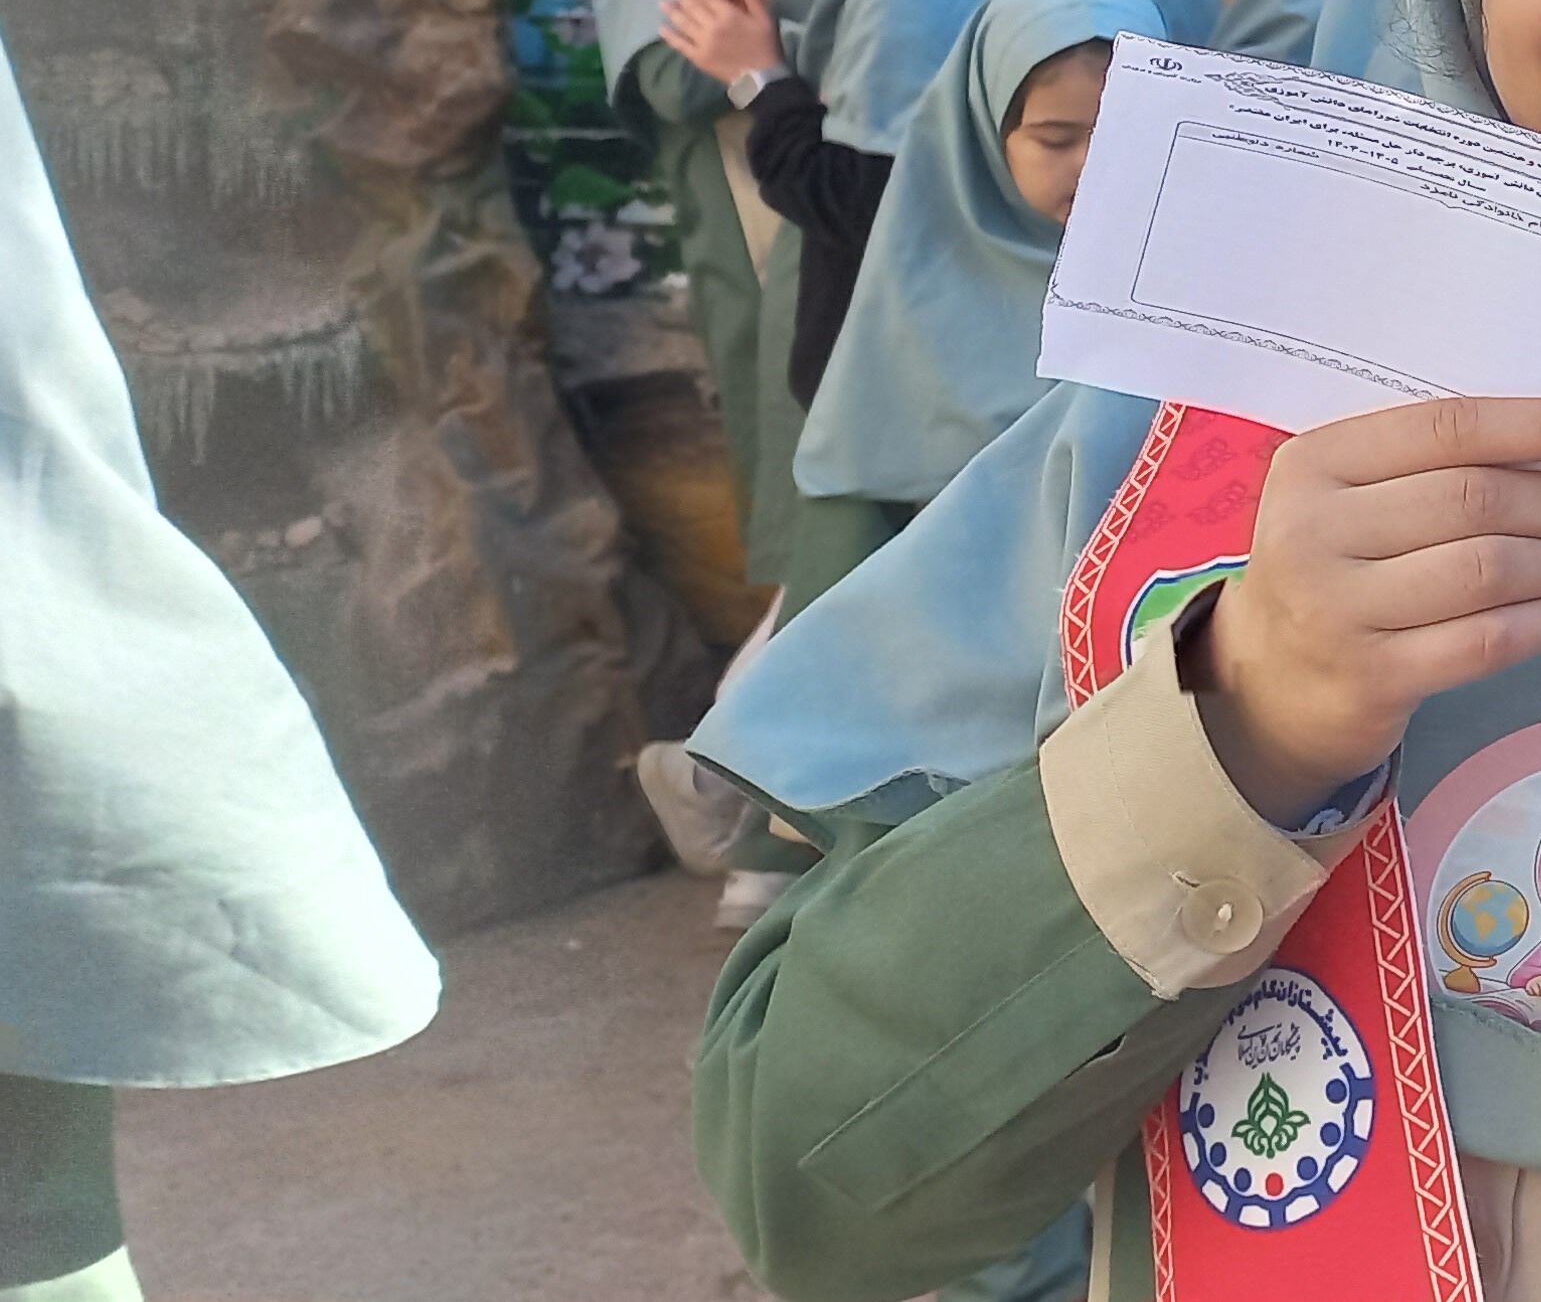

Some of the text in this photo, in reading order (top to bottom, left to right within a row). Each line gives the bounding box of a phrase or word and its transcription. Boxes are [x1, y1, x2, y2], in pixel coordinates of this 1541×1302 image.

[1275, 143, 1320, 160] شماره
[1457, 179, 1487, 192] سال
[1462, 198, 1525, 222] خانوادگی
